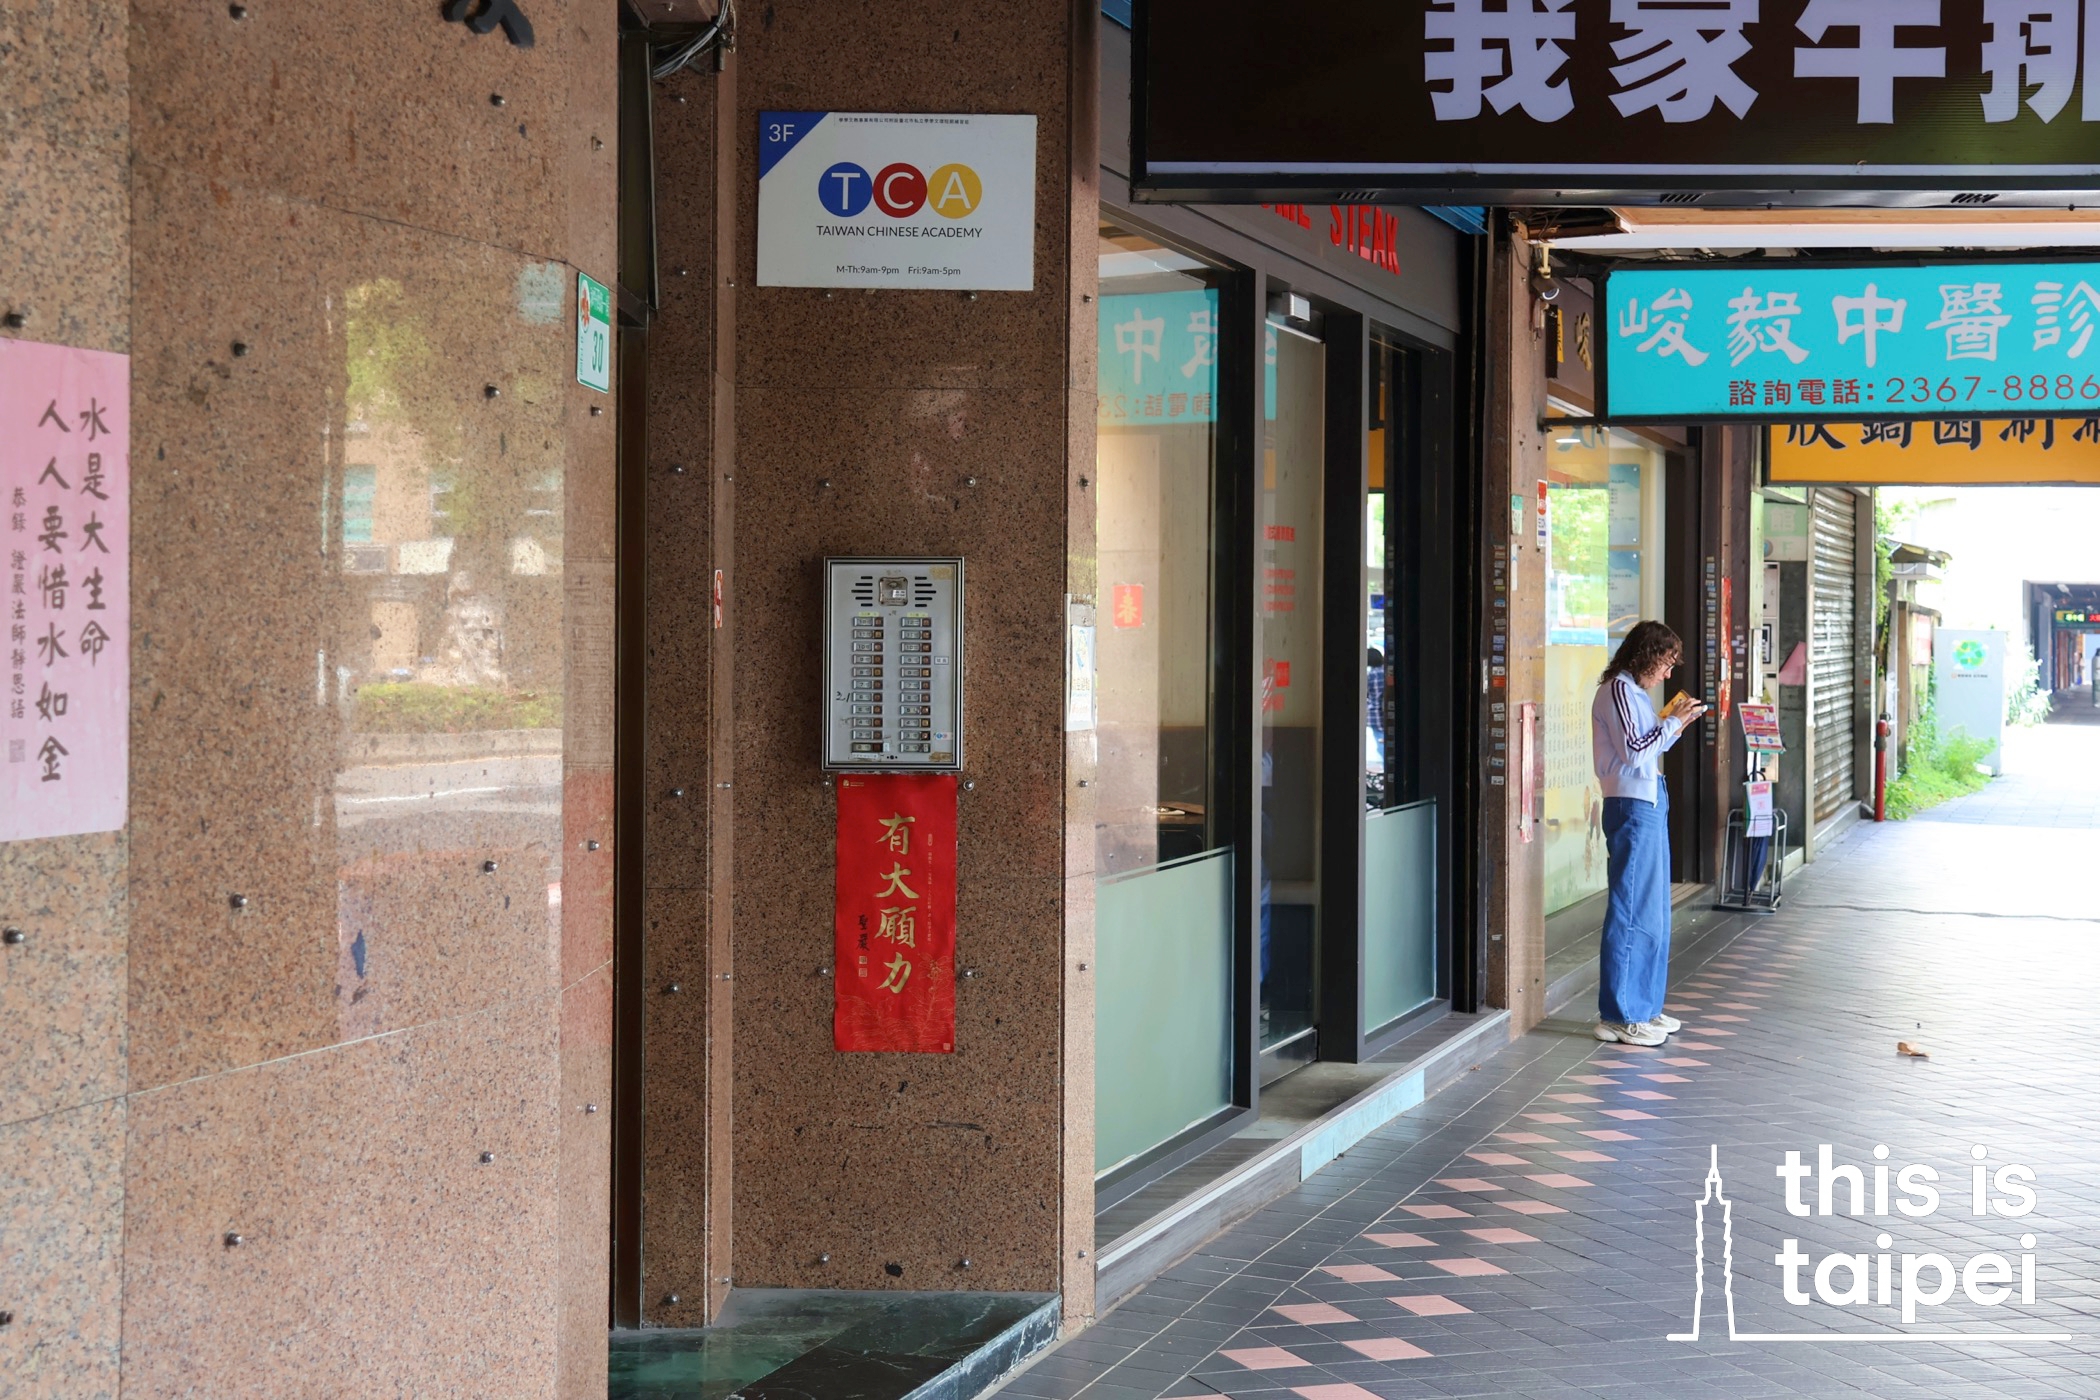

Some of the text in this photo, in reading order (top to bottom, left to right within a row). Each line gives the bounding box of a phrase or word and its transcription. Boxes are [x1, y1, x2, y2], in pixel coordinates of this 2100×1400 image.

[769, 124, 794, 142] 3F
[831, 171, 971, 210] TCA
[817, 226, 983, 238] TAIWAN CHINESE ACADEMY
[1330, 204, 1401, 276] STEAK
[836, 265, 961, 277] M-Th:9am-9pm Fri:9am-5pm
[1618, 280, 2100, 368] 峻毅中醫診
[79, 397, 111, 666] 水是大生命
[36, 399, 72, 782] 人人要惜水如金
[874, 811, 920, 994] 有大願力
